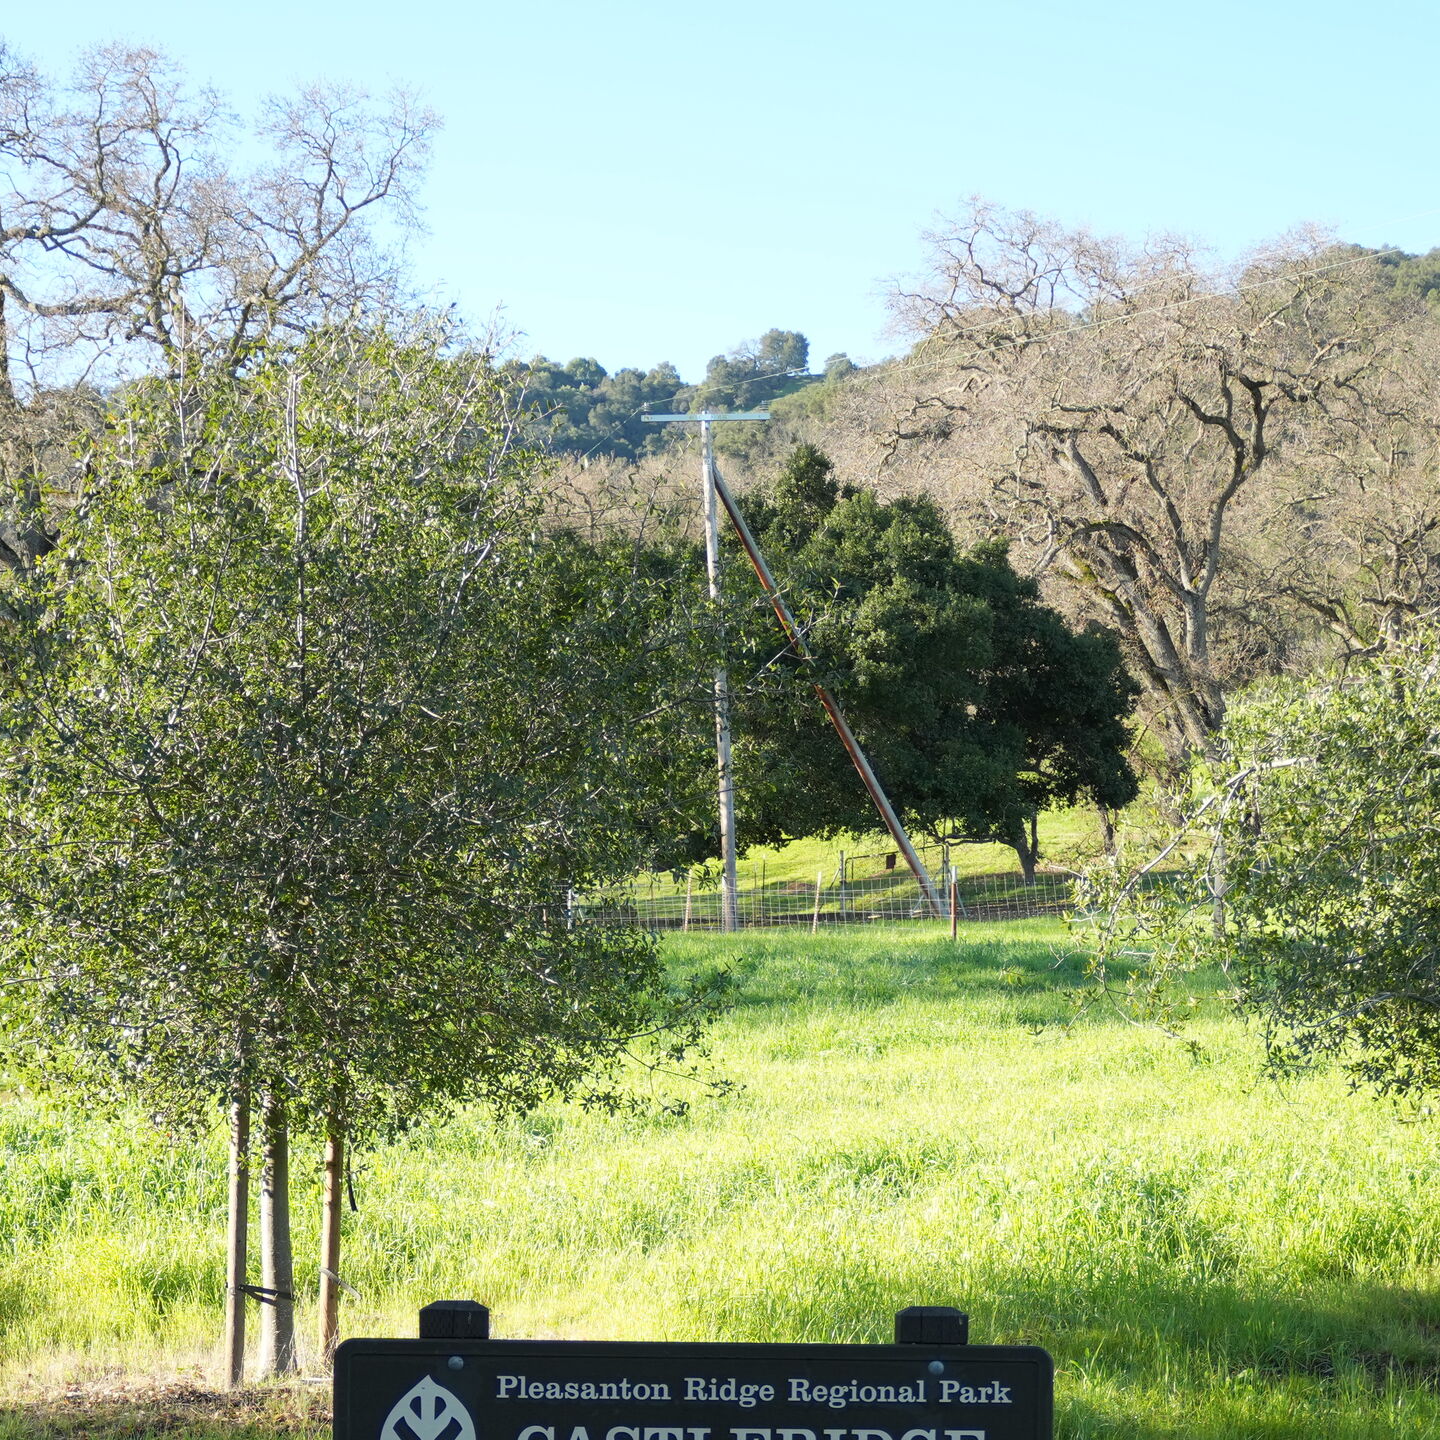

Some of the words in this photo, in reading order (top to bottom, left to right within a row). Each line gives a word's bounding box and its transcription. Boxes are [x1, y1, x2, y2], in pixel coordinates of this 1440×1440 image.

[496, 1375, 672, 1400] Pleasanton
[683, 1377, 775, 1408] Ridge
[787, 1378, 927, 1409] Regional
[938, 1380, 1013, 1404] Park
